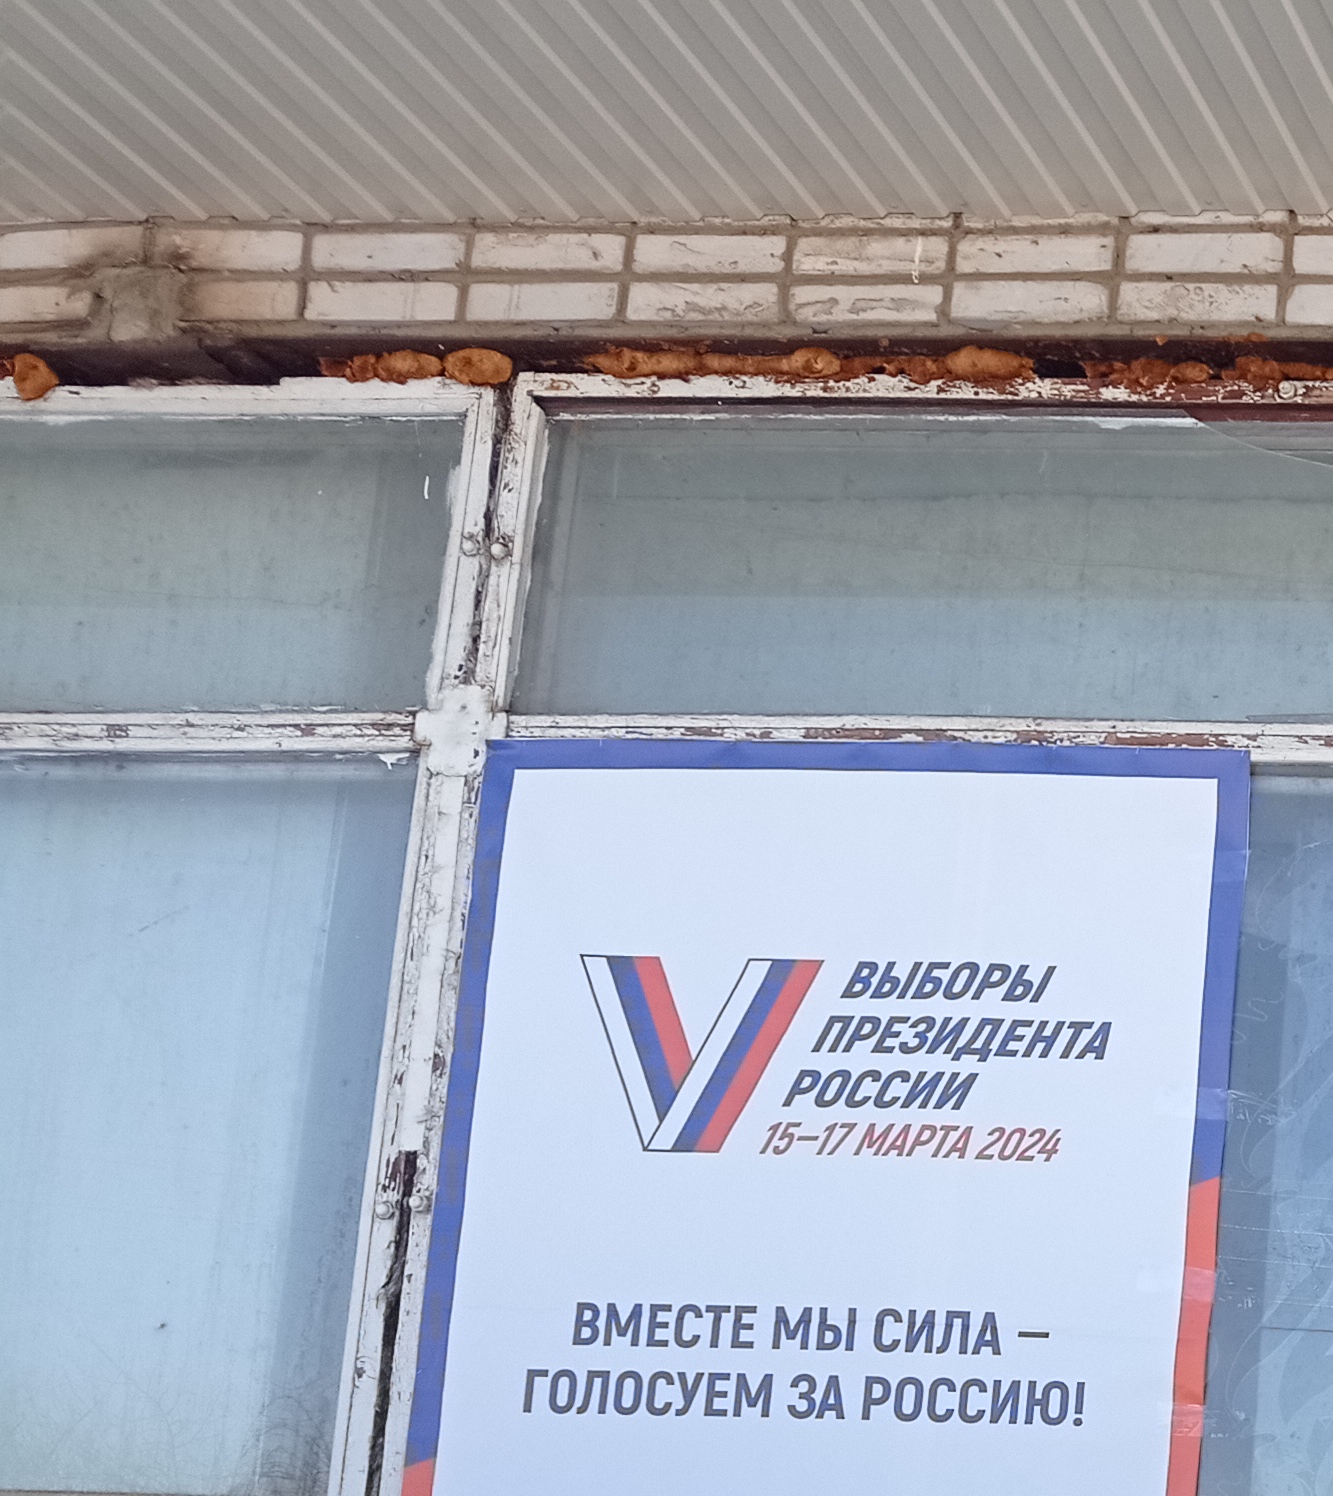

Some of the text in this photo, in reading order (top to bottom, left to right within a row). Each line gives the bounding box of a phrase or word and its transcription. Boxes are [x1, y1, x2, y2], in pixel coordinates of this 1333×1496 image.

[840, 961, 1057, 1003] ВЫБОРЫ
[811, 1015, 1111, 1062] ПРЕЗИДЕНТА
[782, 1070, 978, 1110] РОССИИ
[854, 1123, 975, 1159] МАРТА
[975, 1127, 1062, 1162] 2024
[572, 1302, 757, 1349] ВМЕСТЕ
[772, 1306, 857, 1352] МЫ
[873, 1308, 1001, 1355] СИЛА
[522, 1369, 1085, 1427] ГОЛОСУЕМ ЗА РОССИЮ!
